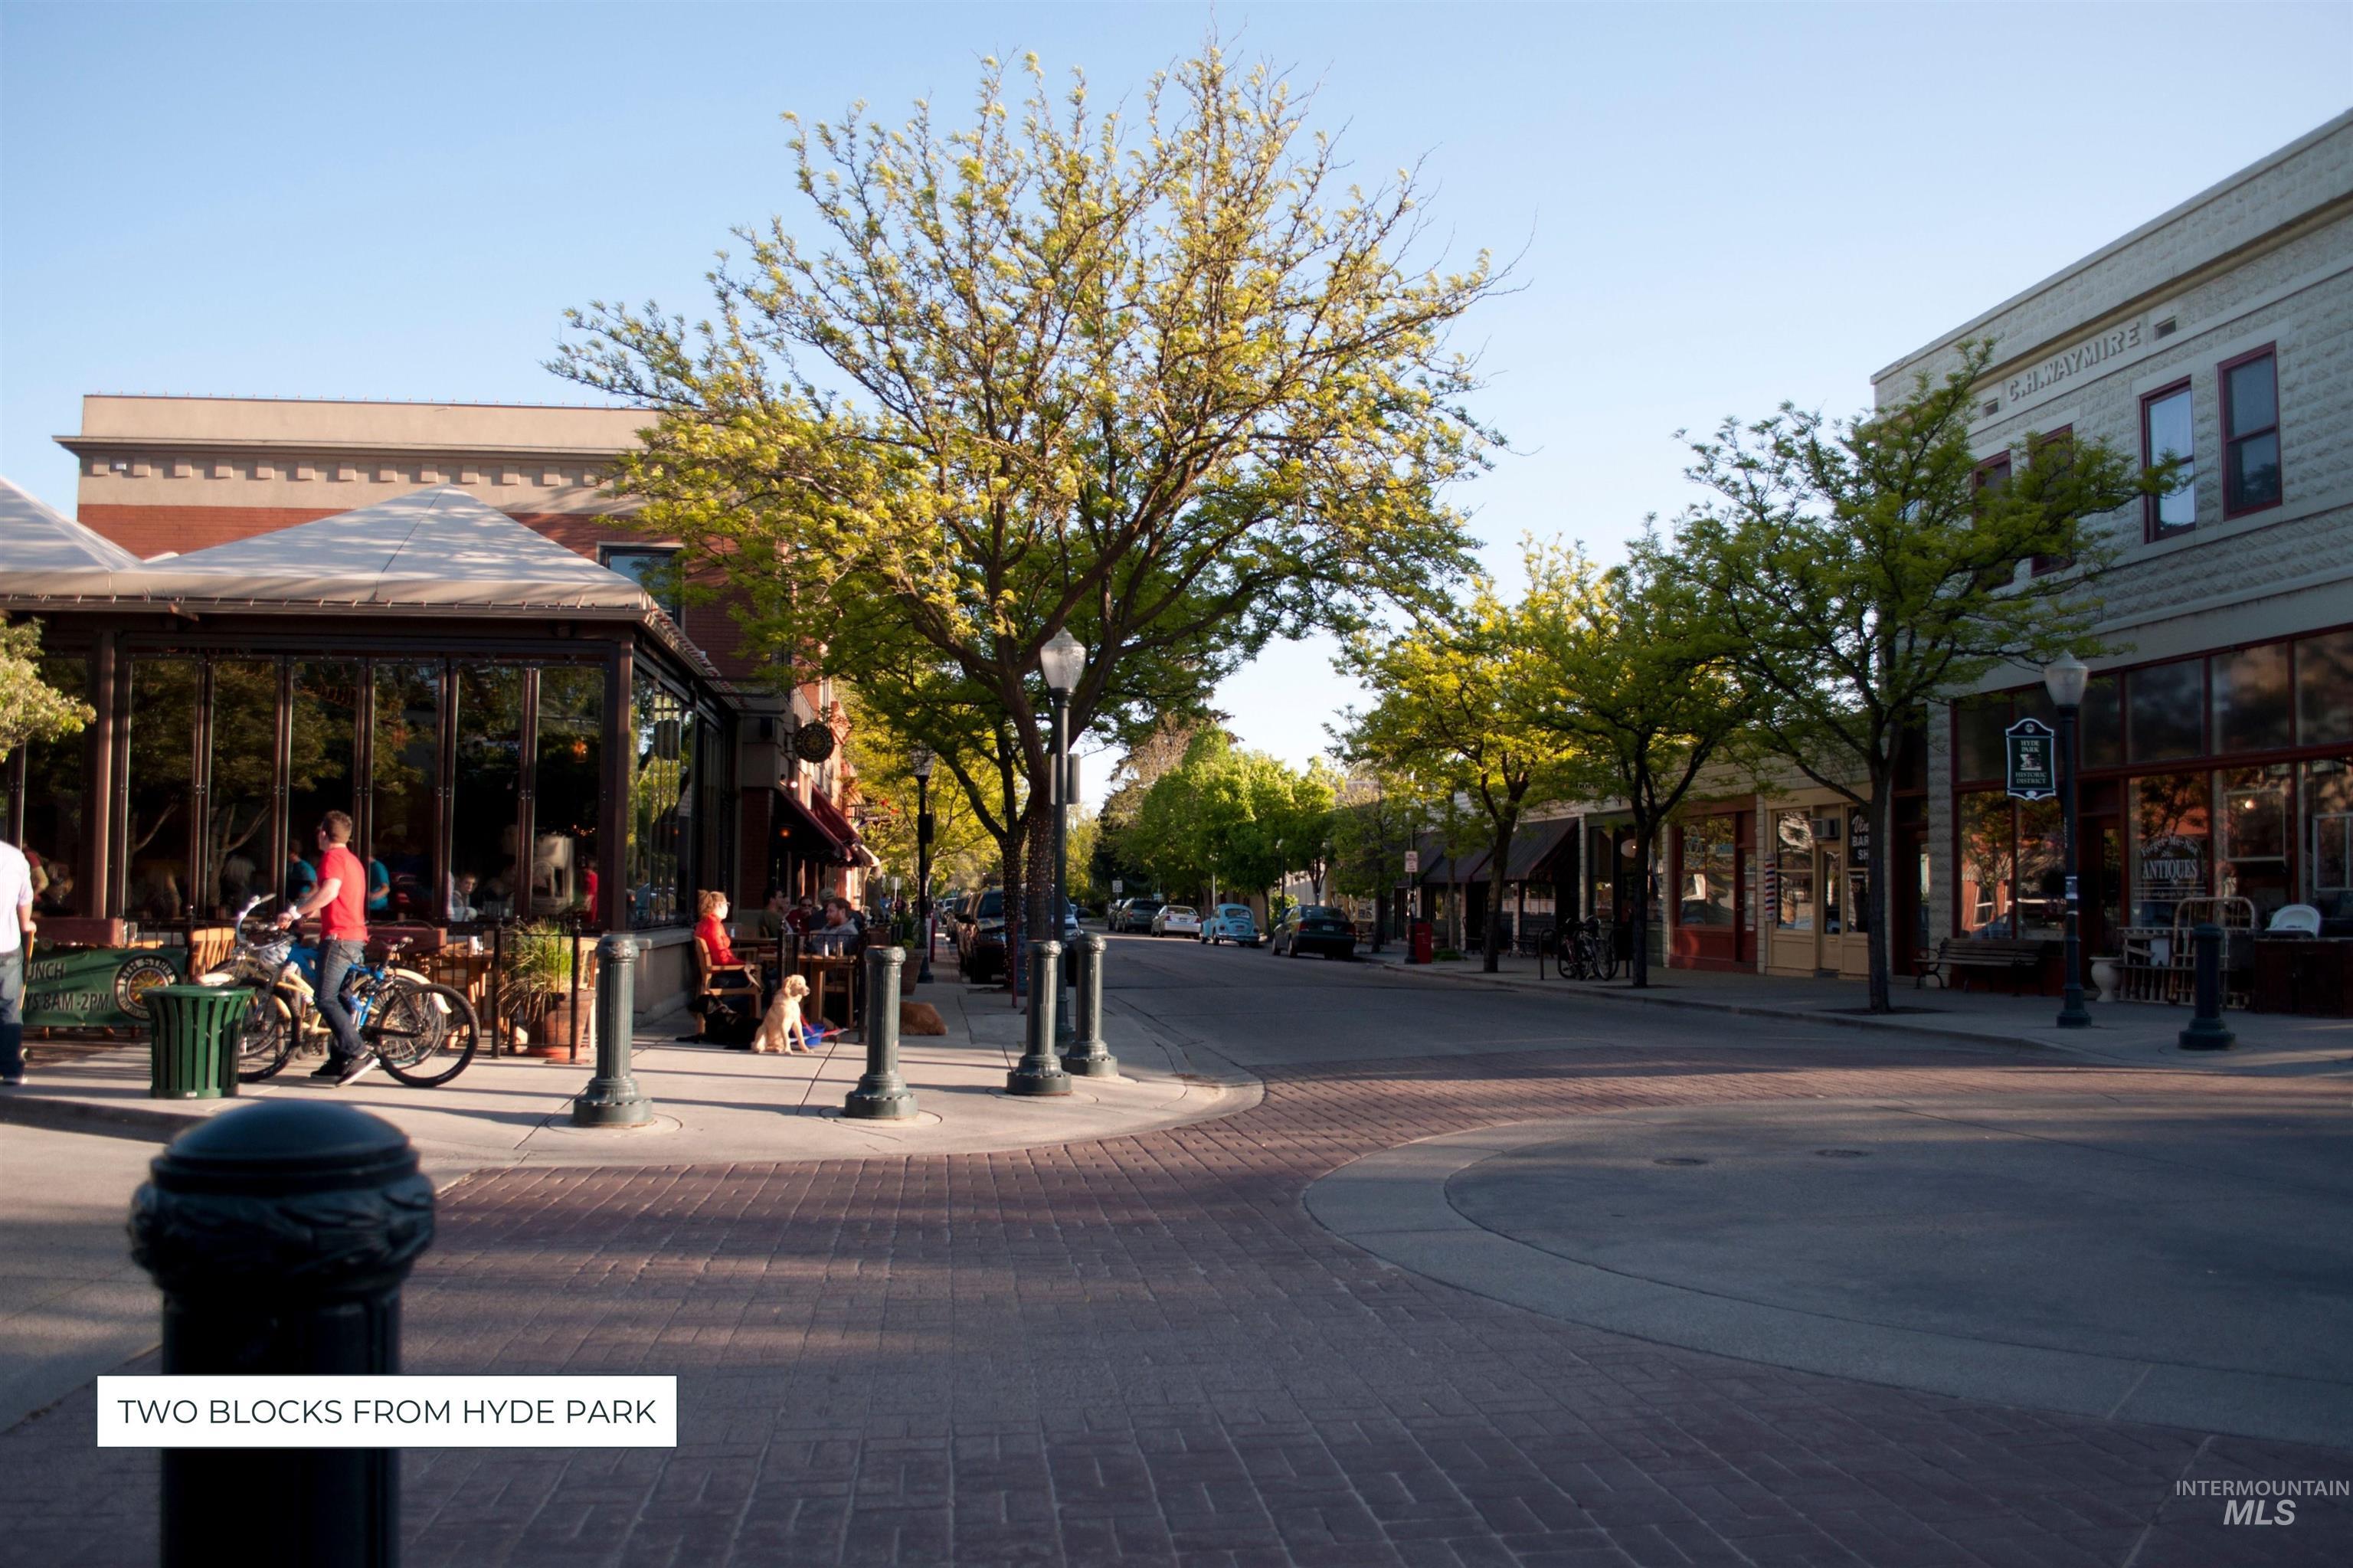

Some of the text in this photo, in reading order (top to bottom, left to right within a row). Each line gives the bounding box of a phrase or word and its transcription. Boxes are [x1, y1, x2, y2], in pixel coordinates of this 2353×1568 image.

[1851, 814, 1869, 833] Vin
[1851, 835, 1869, 847] BAR
[1857, 849, 1869, 860] SH
[2142, 859, 2198, 880] ANTIQUES
[27, 963, 65, 980] UNCH
[43, 993, 74, 1011] 8AM
